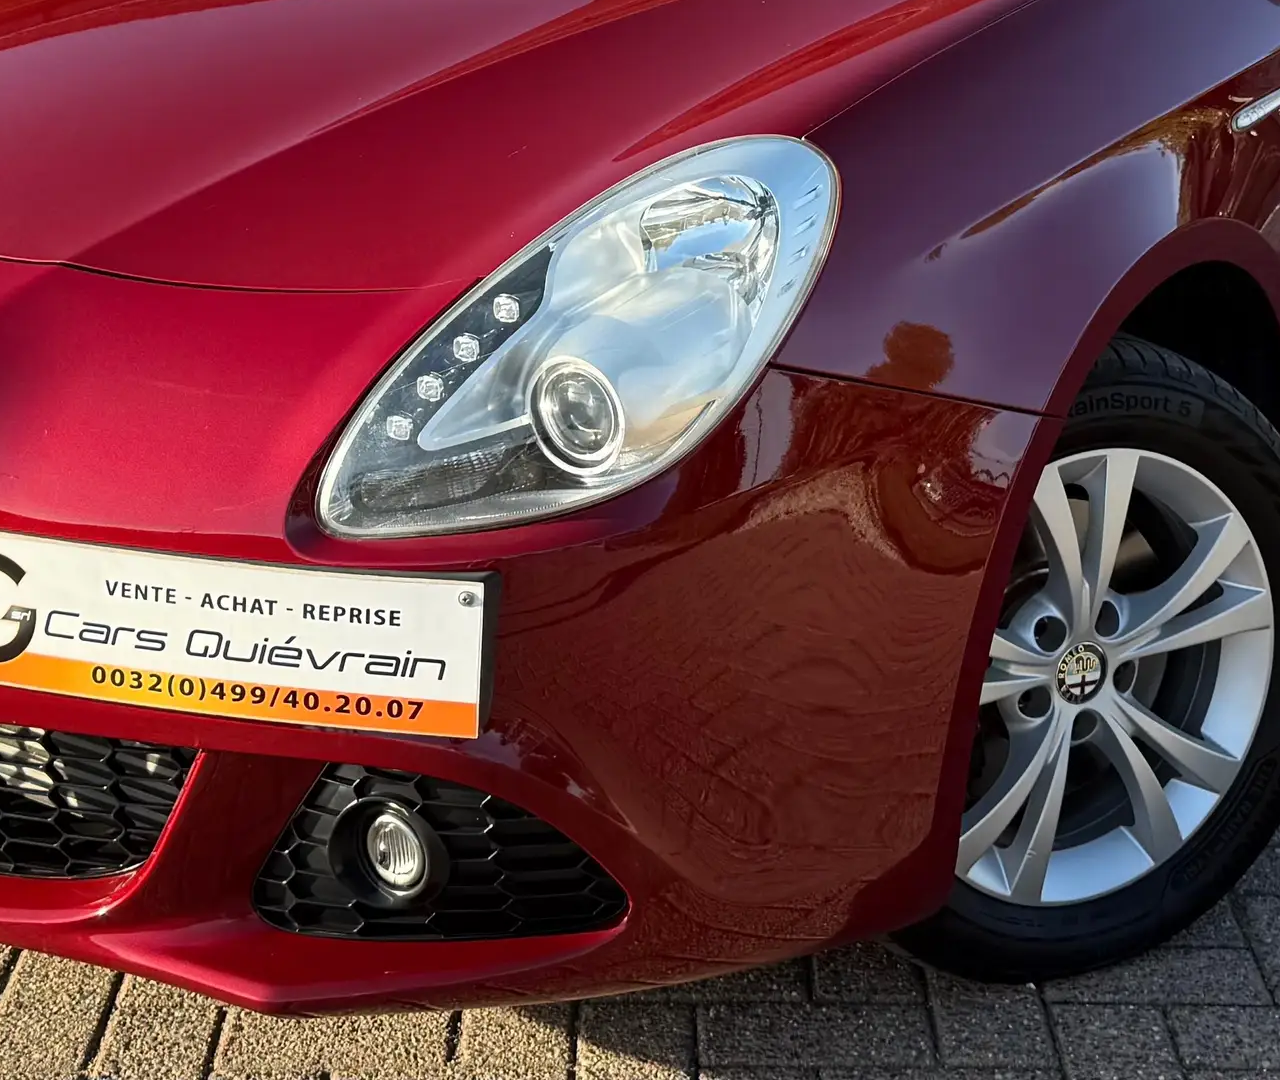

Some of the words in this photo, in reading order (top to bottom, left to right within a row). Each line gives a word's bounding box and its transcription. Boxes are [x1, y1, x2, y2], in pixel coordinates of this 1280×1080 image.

[1066, 391, 1173, 418] ainSport
[1177, 399, 1193, 419] 5
[104, 578, 178, 605] VENTE
[200, 592, 279, 617] ACHAT
[301, 601, 403, 628] REPRISE
[43, 608, 169, 653] Cars
[185, 628, 447, 682] Quiévrain
[90, 665, 425, 722] 0032(0)499/40.20.07
